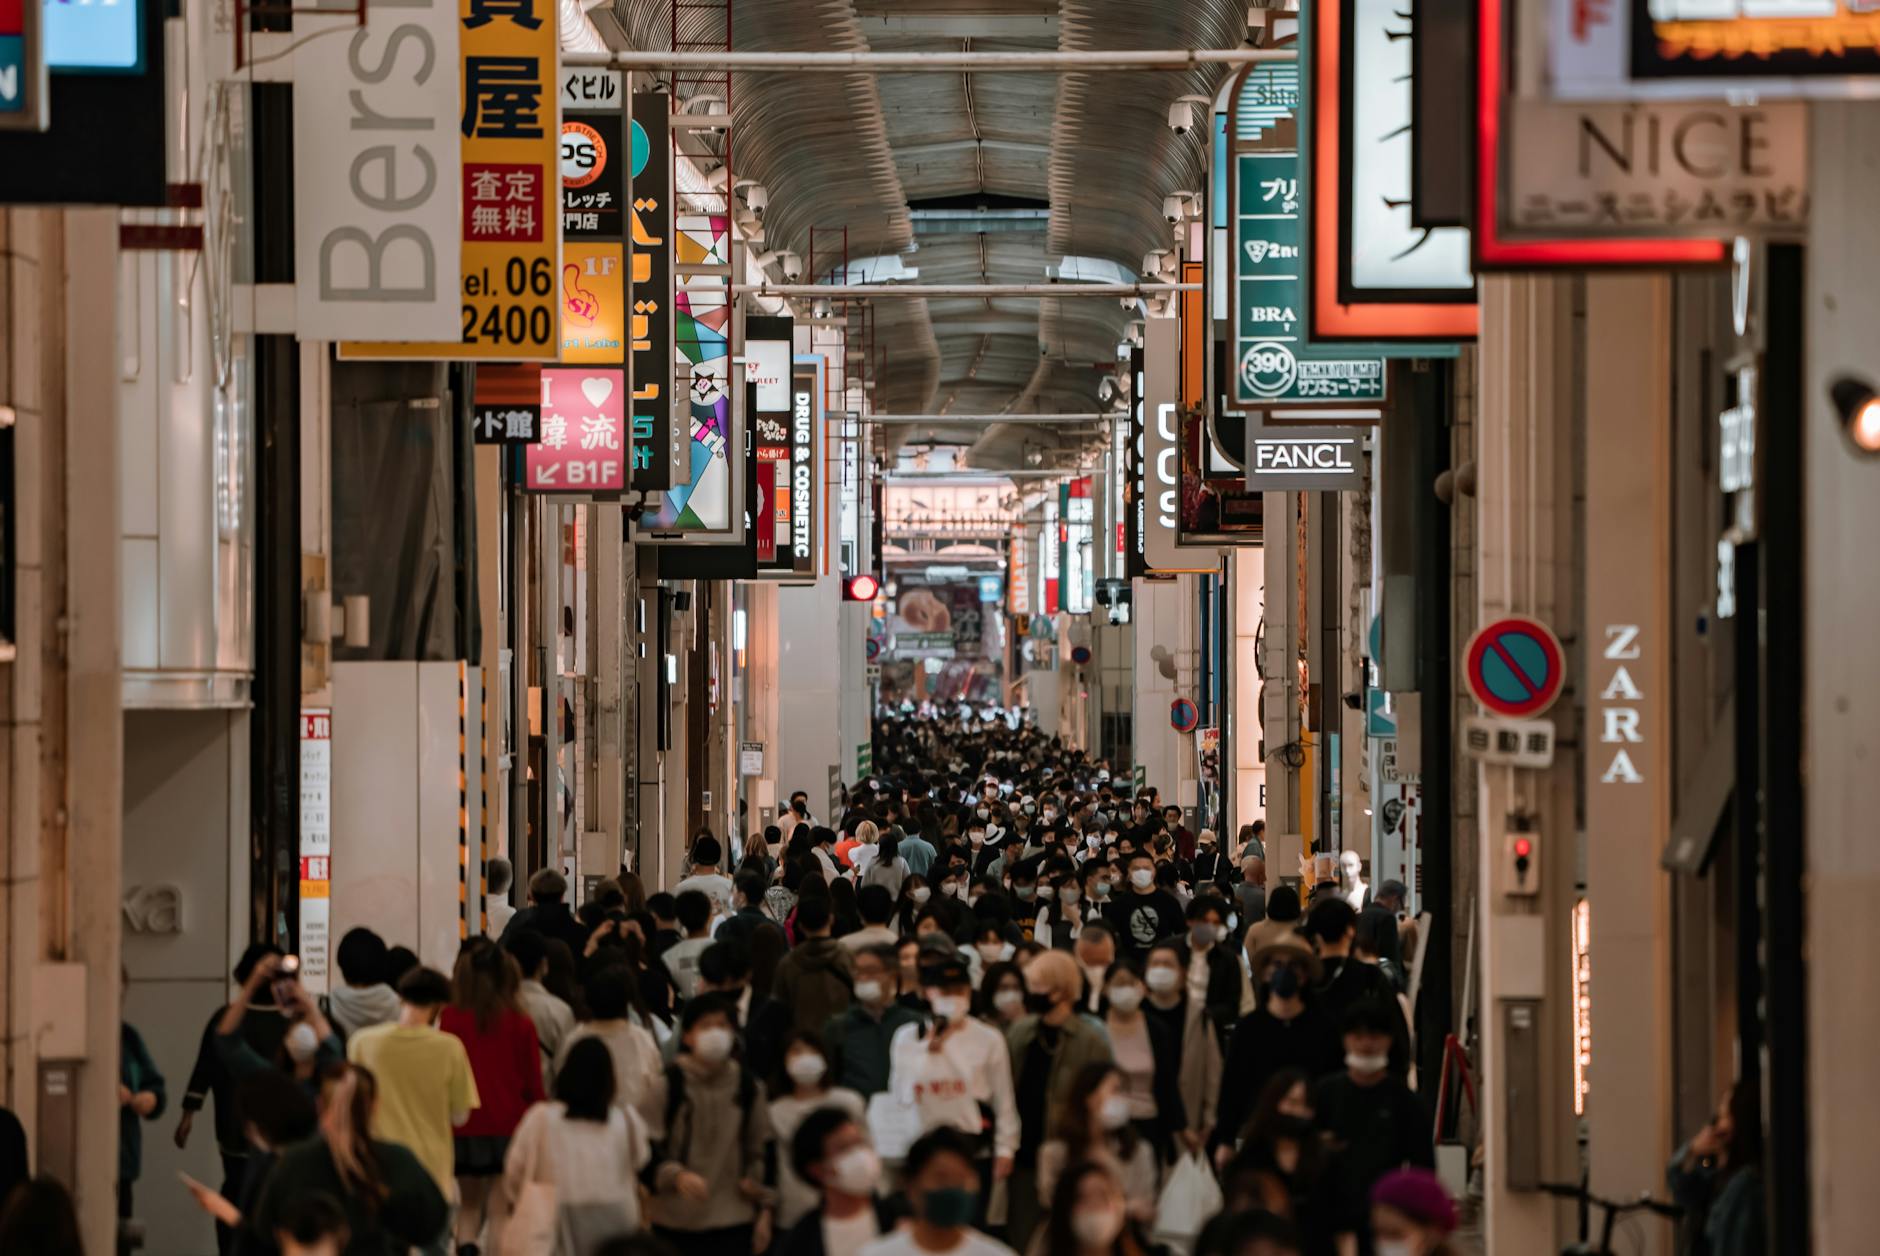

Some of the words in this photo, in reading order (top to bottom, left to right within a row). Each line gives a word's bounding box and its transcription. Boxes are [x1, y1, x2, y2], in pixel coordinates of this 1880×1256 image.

[562, 74, 615, 101] ぐビル
[319, 0, 437, 302] Bers
[1578, 112, 1775, 178] NICE
[471, 170, 536, 202] 査定
[1260, 178, 1298, 201] プリ
[471, 204, 536, 236] 無料
[461, 267, 498, 297] el.
[506, 256, 551, 297] 06
[584, 257, 617, 276] 1F
[462, 304, 551, 345] 2400
[1249, 353, 1291, 374] 390
[795, 391, 811, 444] DRUG
[795, 447, 811, 463] &
[1256, 443, 1352, 468] FANCL
[566, 460, 619, 485] B1F
[795, 465, 811, 558] COSMETIC
[1601, 624, 1644, 784] ZARA
